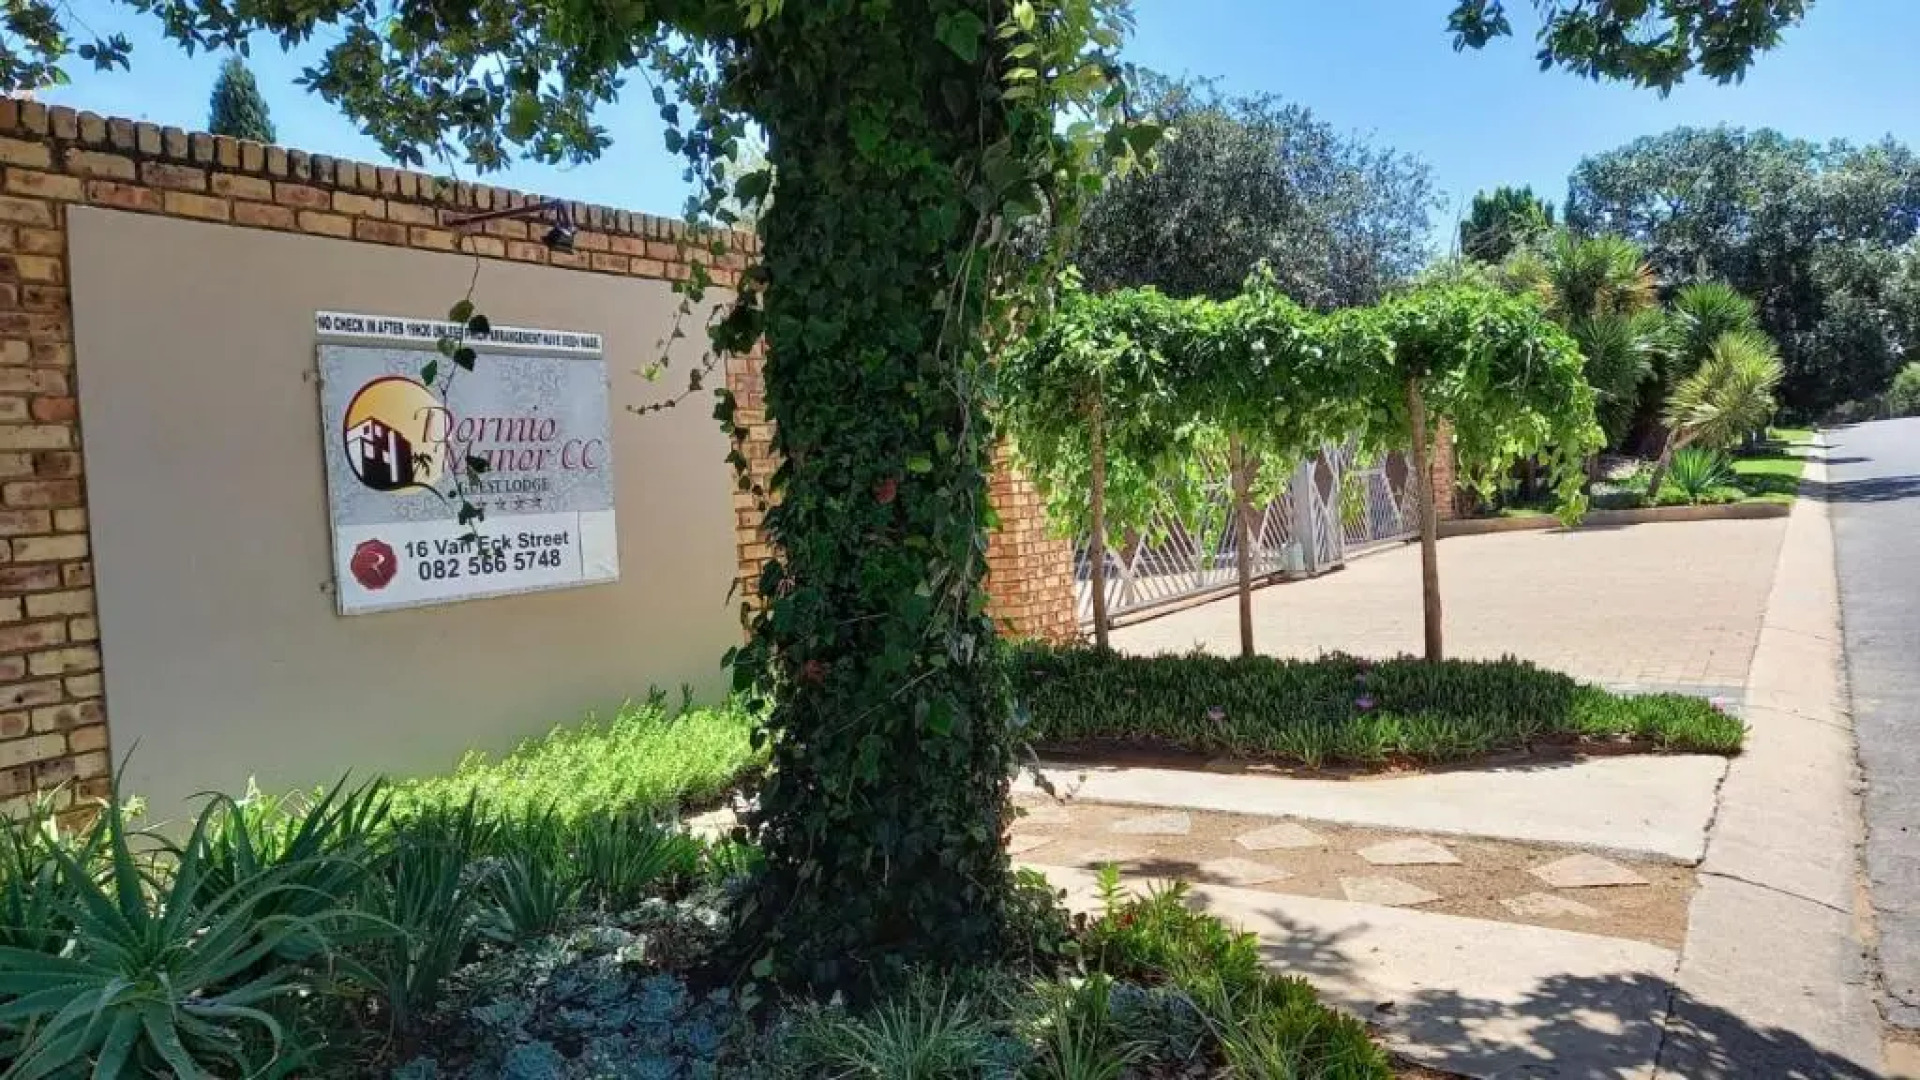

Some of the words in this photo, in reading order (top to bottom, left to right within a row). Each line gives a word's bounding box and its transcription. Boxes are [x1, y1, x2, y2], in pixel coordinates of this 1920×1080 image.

[317, 315, 332, 331] NO
[333, 316, 365, 333] CHECK
[365, 318, 376, 333] IN
[377, 320, 404, 335] AFTER
[414, 405, 556, 443] Dormio
[435, 442, 552, 474] Mnor
[562, 438, 602, 471] CC
[505, 478, 549, 493] LODGE
[405, 540, 428, 558] 16
[434, 538, 471, 555] Van
[477, 534, 511, 552] Eck
[518, 531, 569, 547] Street
[419, 558, 460, 580] 082
[468, 554, 507, 575] 566
[514, 549, 562, 571] 5748
